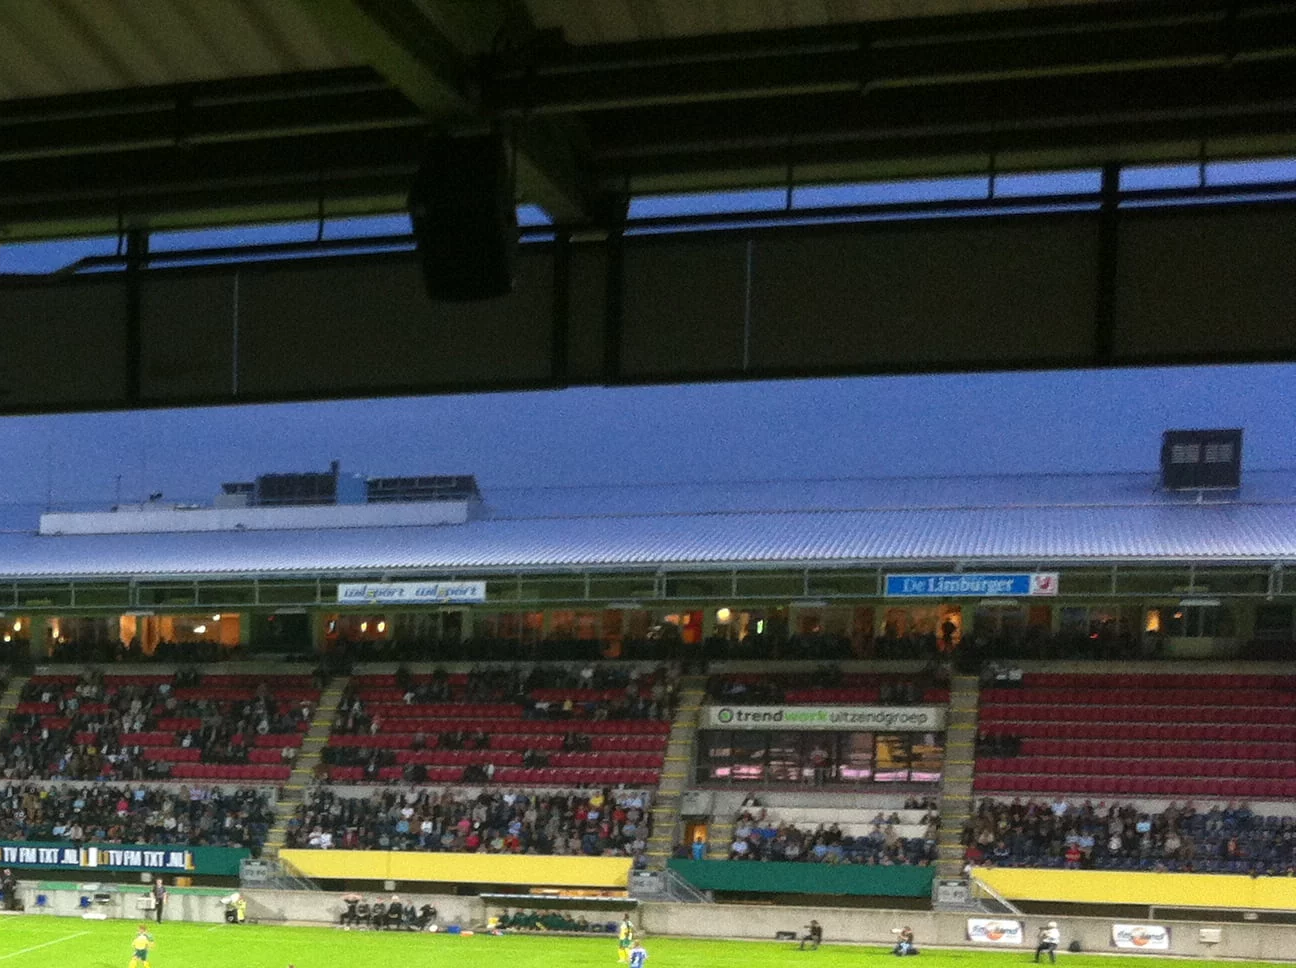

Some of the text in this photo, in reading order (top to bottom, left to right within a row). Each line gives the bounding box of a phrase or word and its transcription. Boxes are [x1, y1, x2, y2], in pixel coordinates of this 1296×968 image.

[928, 576, 1014, 594] Limburger
[3, 847, 18, 862] TV
[19, 848, 37, 863] FM
[38, 848, 59, 863] TXT
[109, 850, 122, 865] TV
[123, 850, 141, 866] FM
[143, 851, 165, 867] TXT
